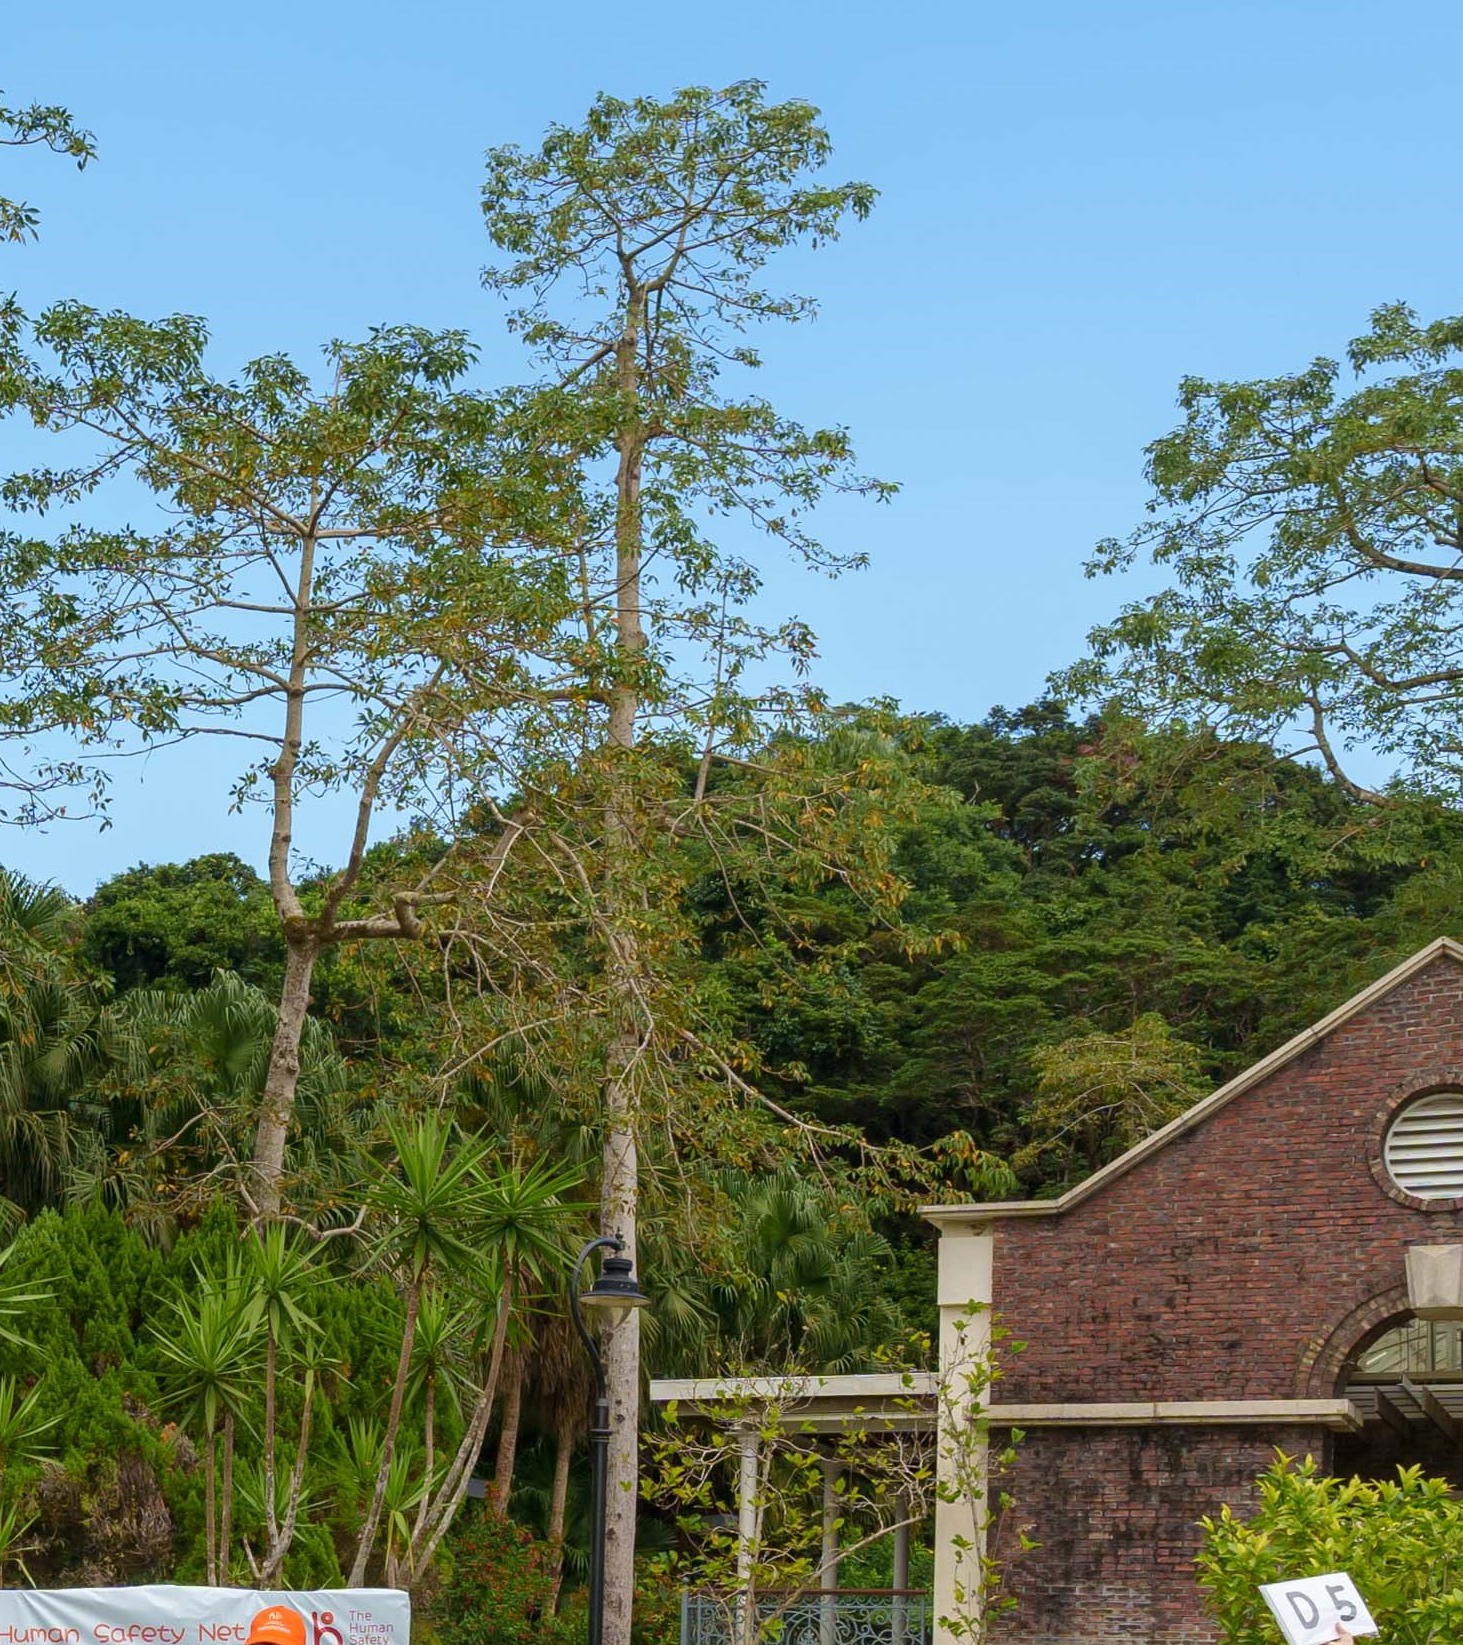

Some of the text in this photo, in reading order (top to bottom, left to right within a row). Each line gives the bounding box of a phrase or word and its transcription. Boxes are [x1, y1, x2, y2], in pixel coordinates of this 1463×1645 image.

[348, 1610, 372, 1621] The
[349, 1622, 394, 1633] Human
[93, 1624, 186, 1645] Safety
[198, 1624, 246, 1642] Net
